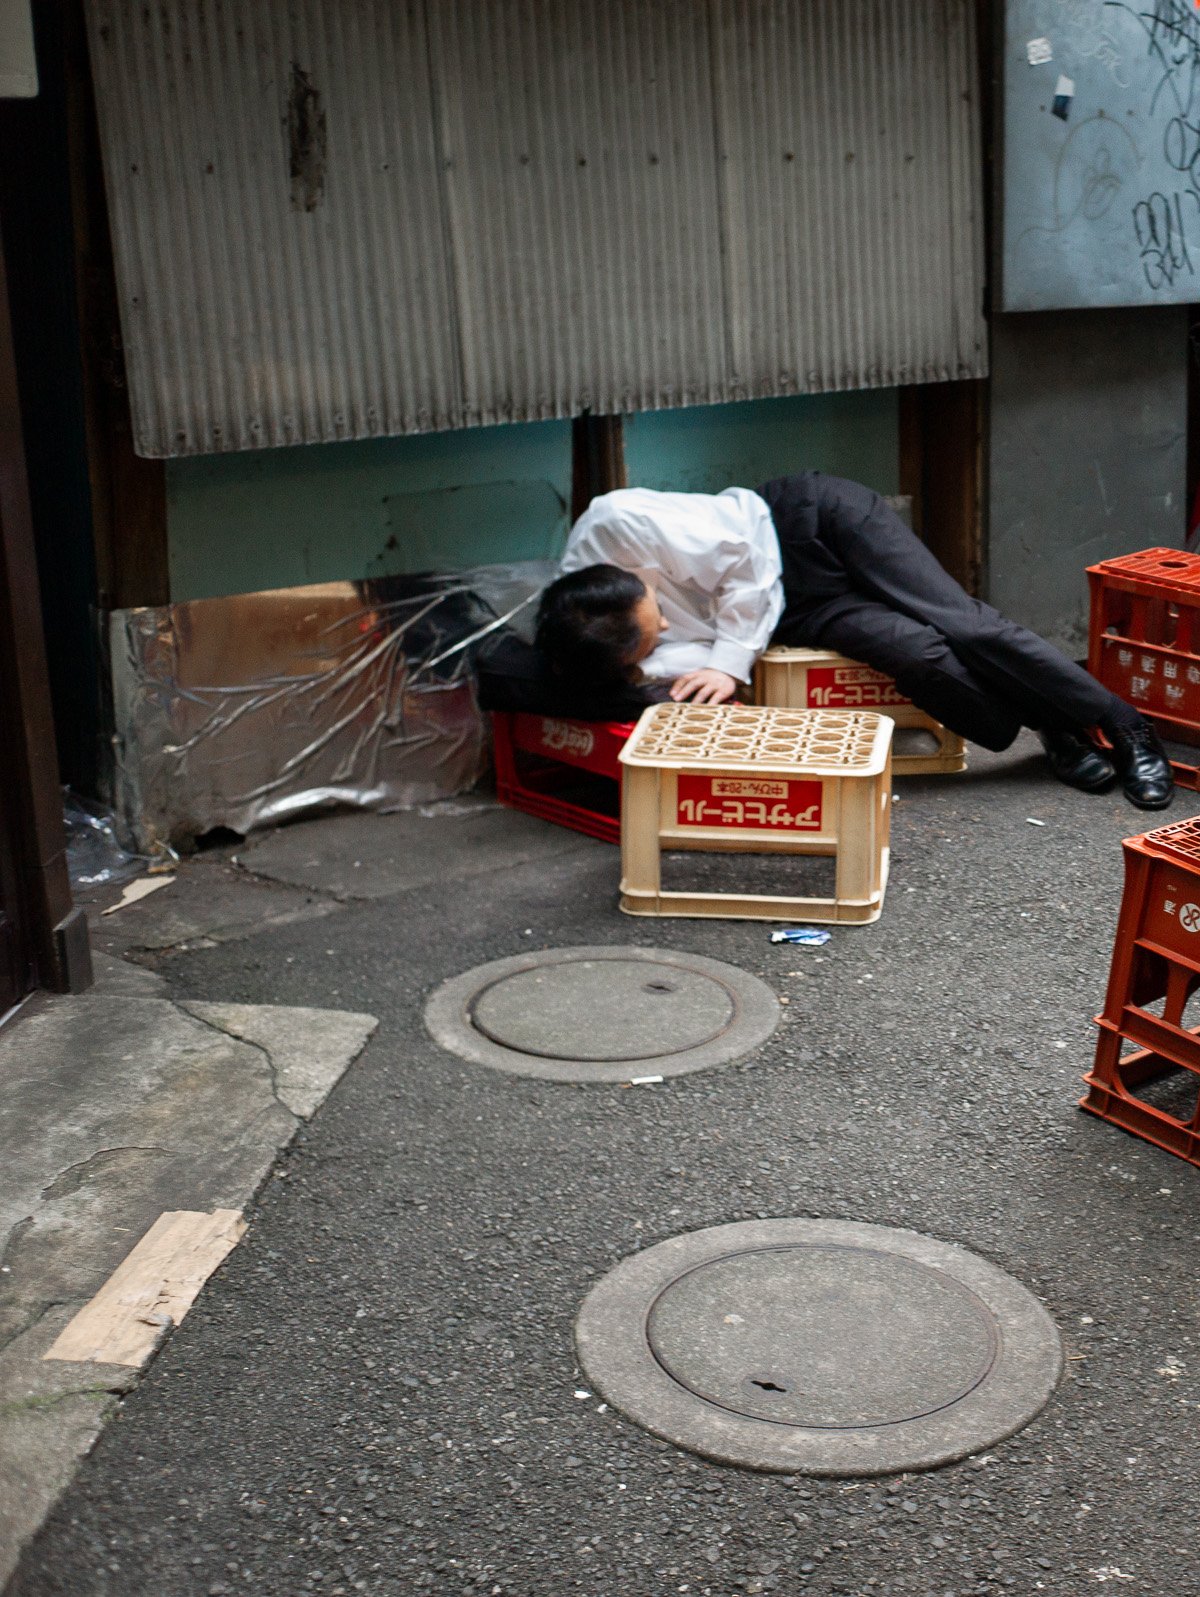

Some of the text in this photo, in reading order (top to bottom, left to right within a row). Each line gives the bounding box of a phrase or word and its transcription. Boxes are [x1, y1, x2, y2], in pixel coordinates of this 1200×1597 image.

[810, 684, 912, 706] サヒビール
[679, 798, 820, 827] アサヒビール
